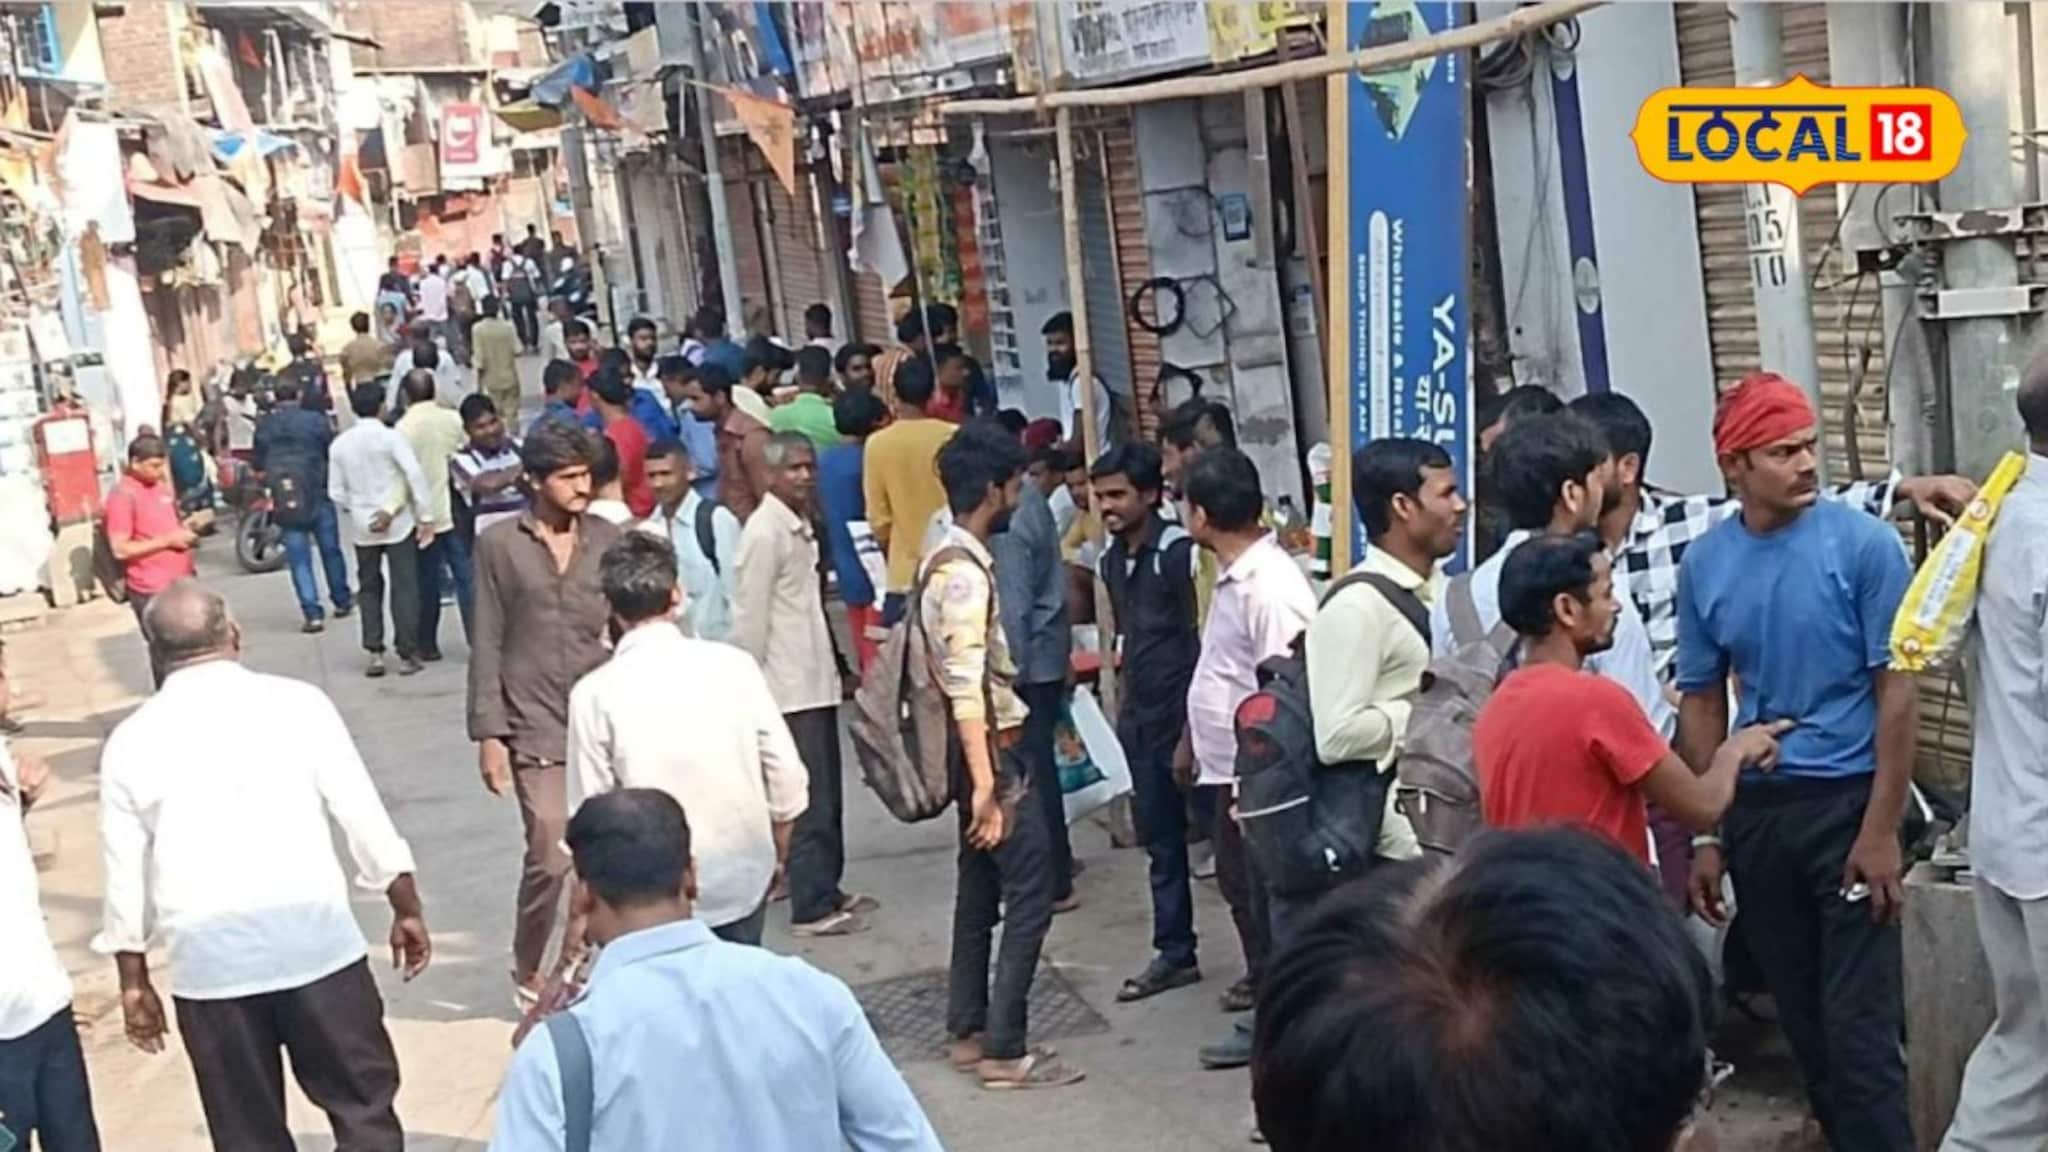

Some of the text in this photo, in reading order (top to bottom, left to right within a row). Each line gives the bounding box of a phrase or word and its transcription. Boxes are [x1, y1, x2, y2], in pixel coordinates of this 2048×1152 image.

[1357, 253, 1367, 304] SHOP
[1392, 218, 1404, 346] Wholesale
[1754, 256, 1787, 289] 10
[1393, 352, 1404, 369] &
[1358, 404, 1368, 433] AM
